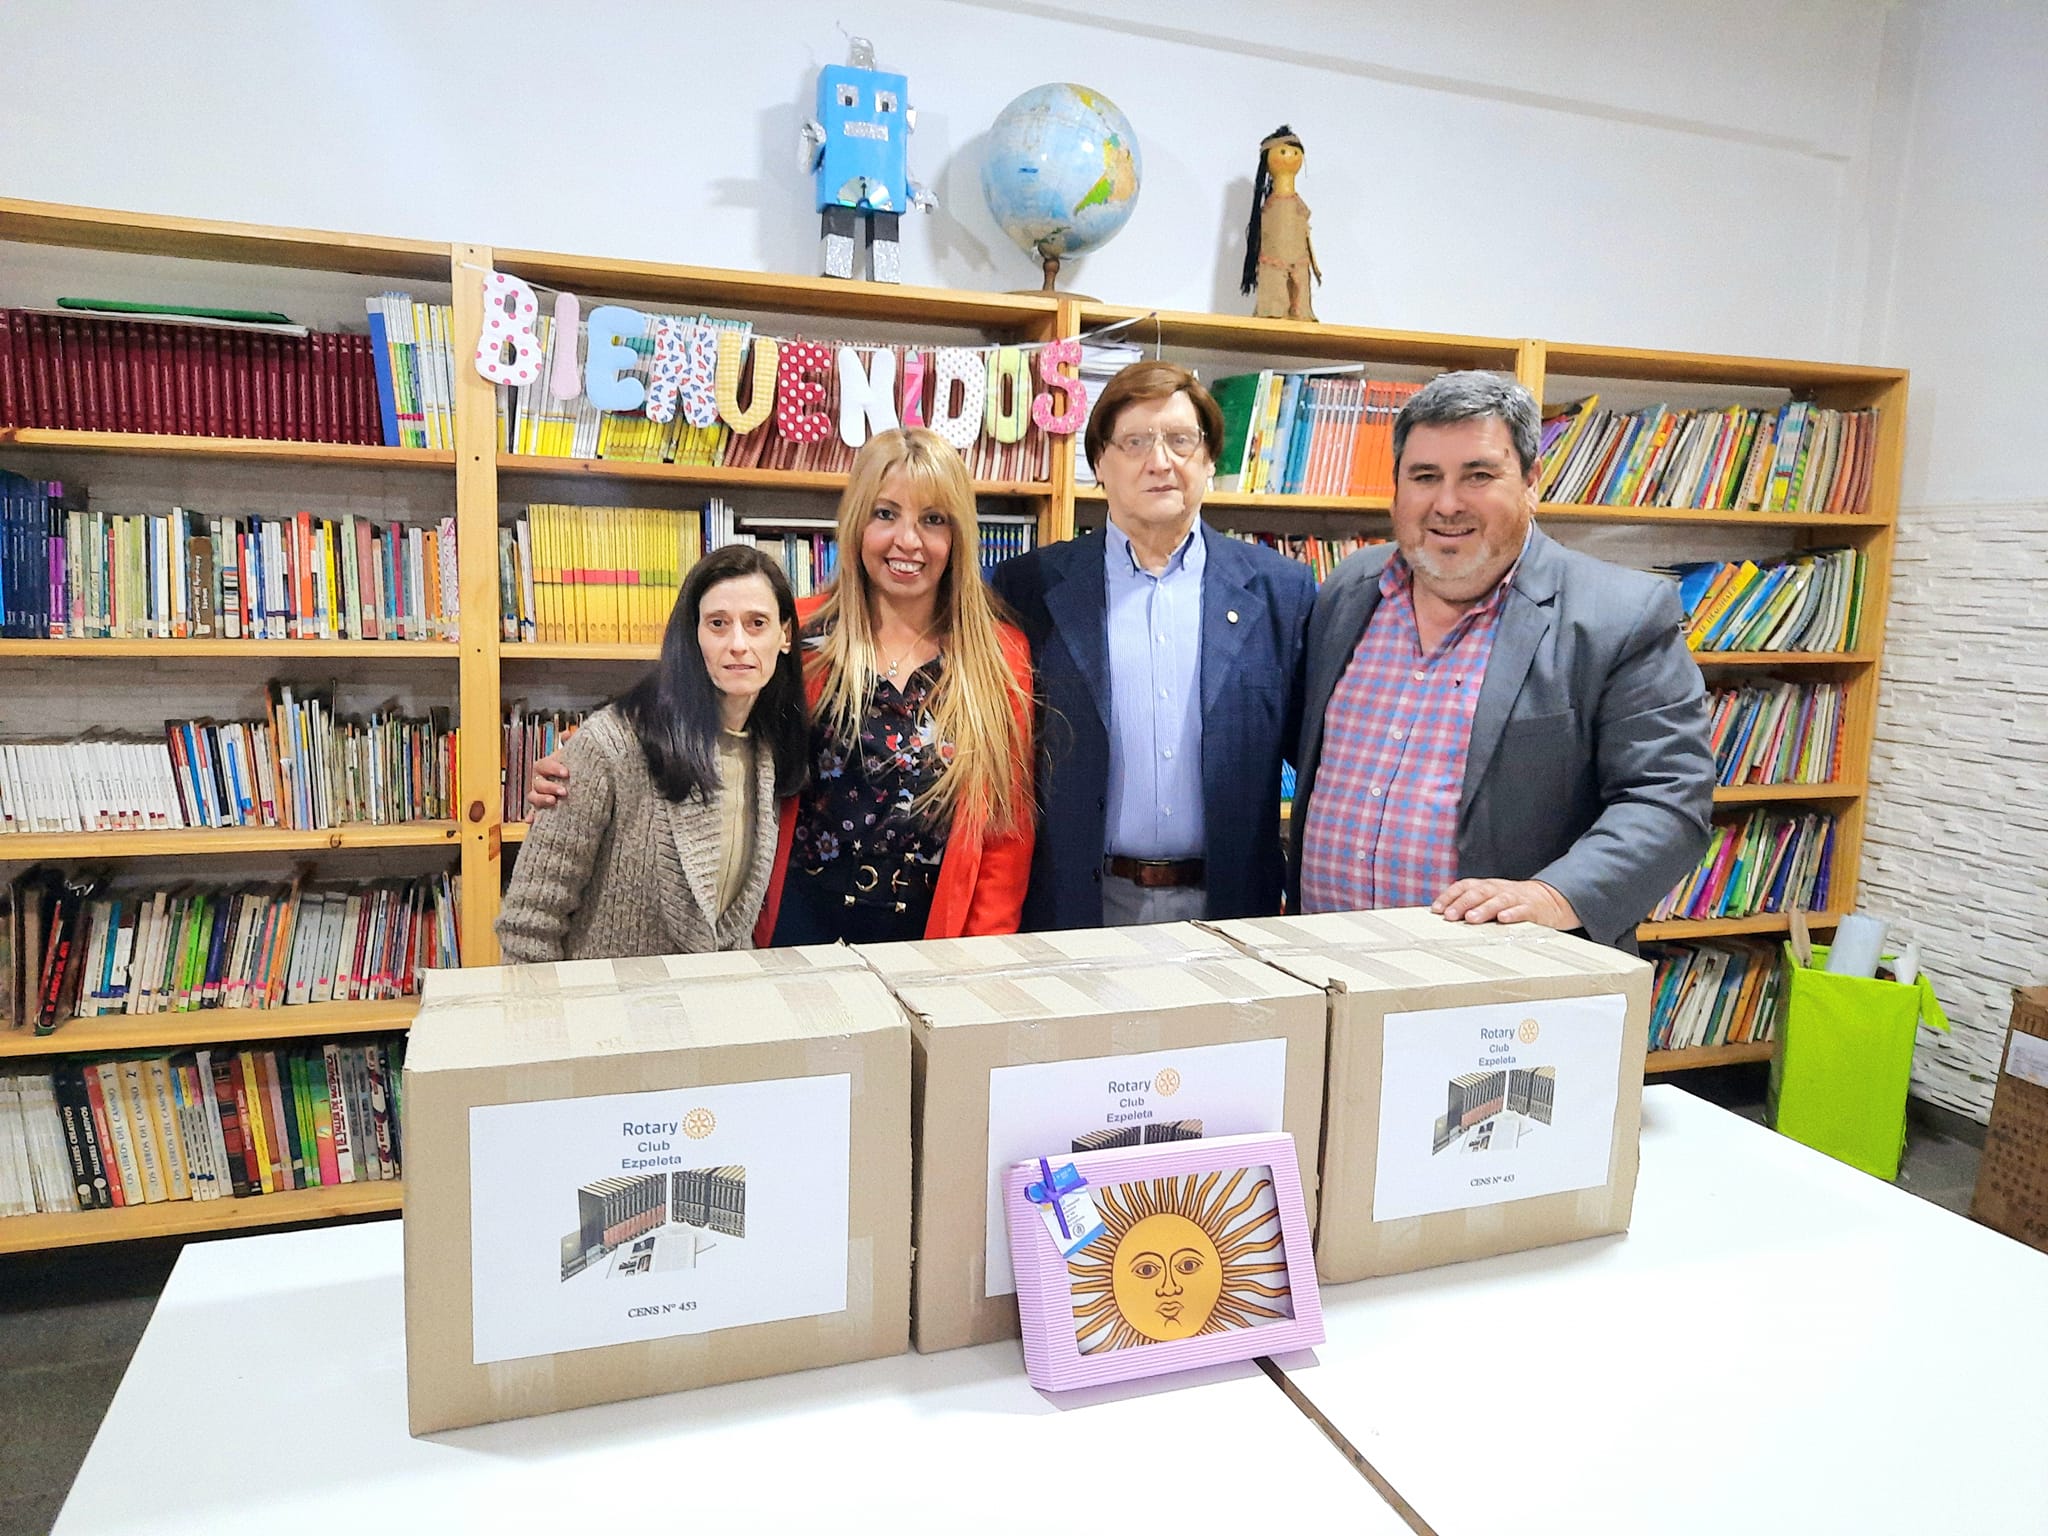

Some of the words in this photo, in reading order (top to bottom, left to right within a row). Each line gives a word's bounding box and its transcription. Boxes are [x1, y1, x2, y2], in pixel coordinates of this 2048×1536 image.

[1480, 1027, 1515, 1041] Rotary
[1489, 1043, 1510, 1054] Club
[1478, 1055, 1517, 1067] Ezpeleta
[1108, 1080, 1151, 1095] Rotary
[1119, 1096, 1145, 1109] Club
[1106, 1110, 1153, 1123] Ezpeleta
[622, 1119, 679, 1137] Rotary
[637, 1140, 671, 1153] Club
[621, 1154, 682, 1170] Ezpeleta
[1470, 1177, 1491, 1188] CENS
[627, 1305, 660, 1319] CENS
[678, 1300, 698, 1312] 453
